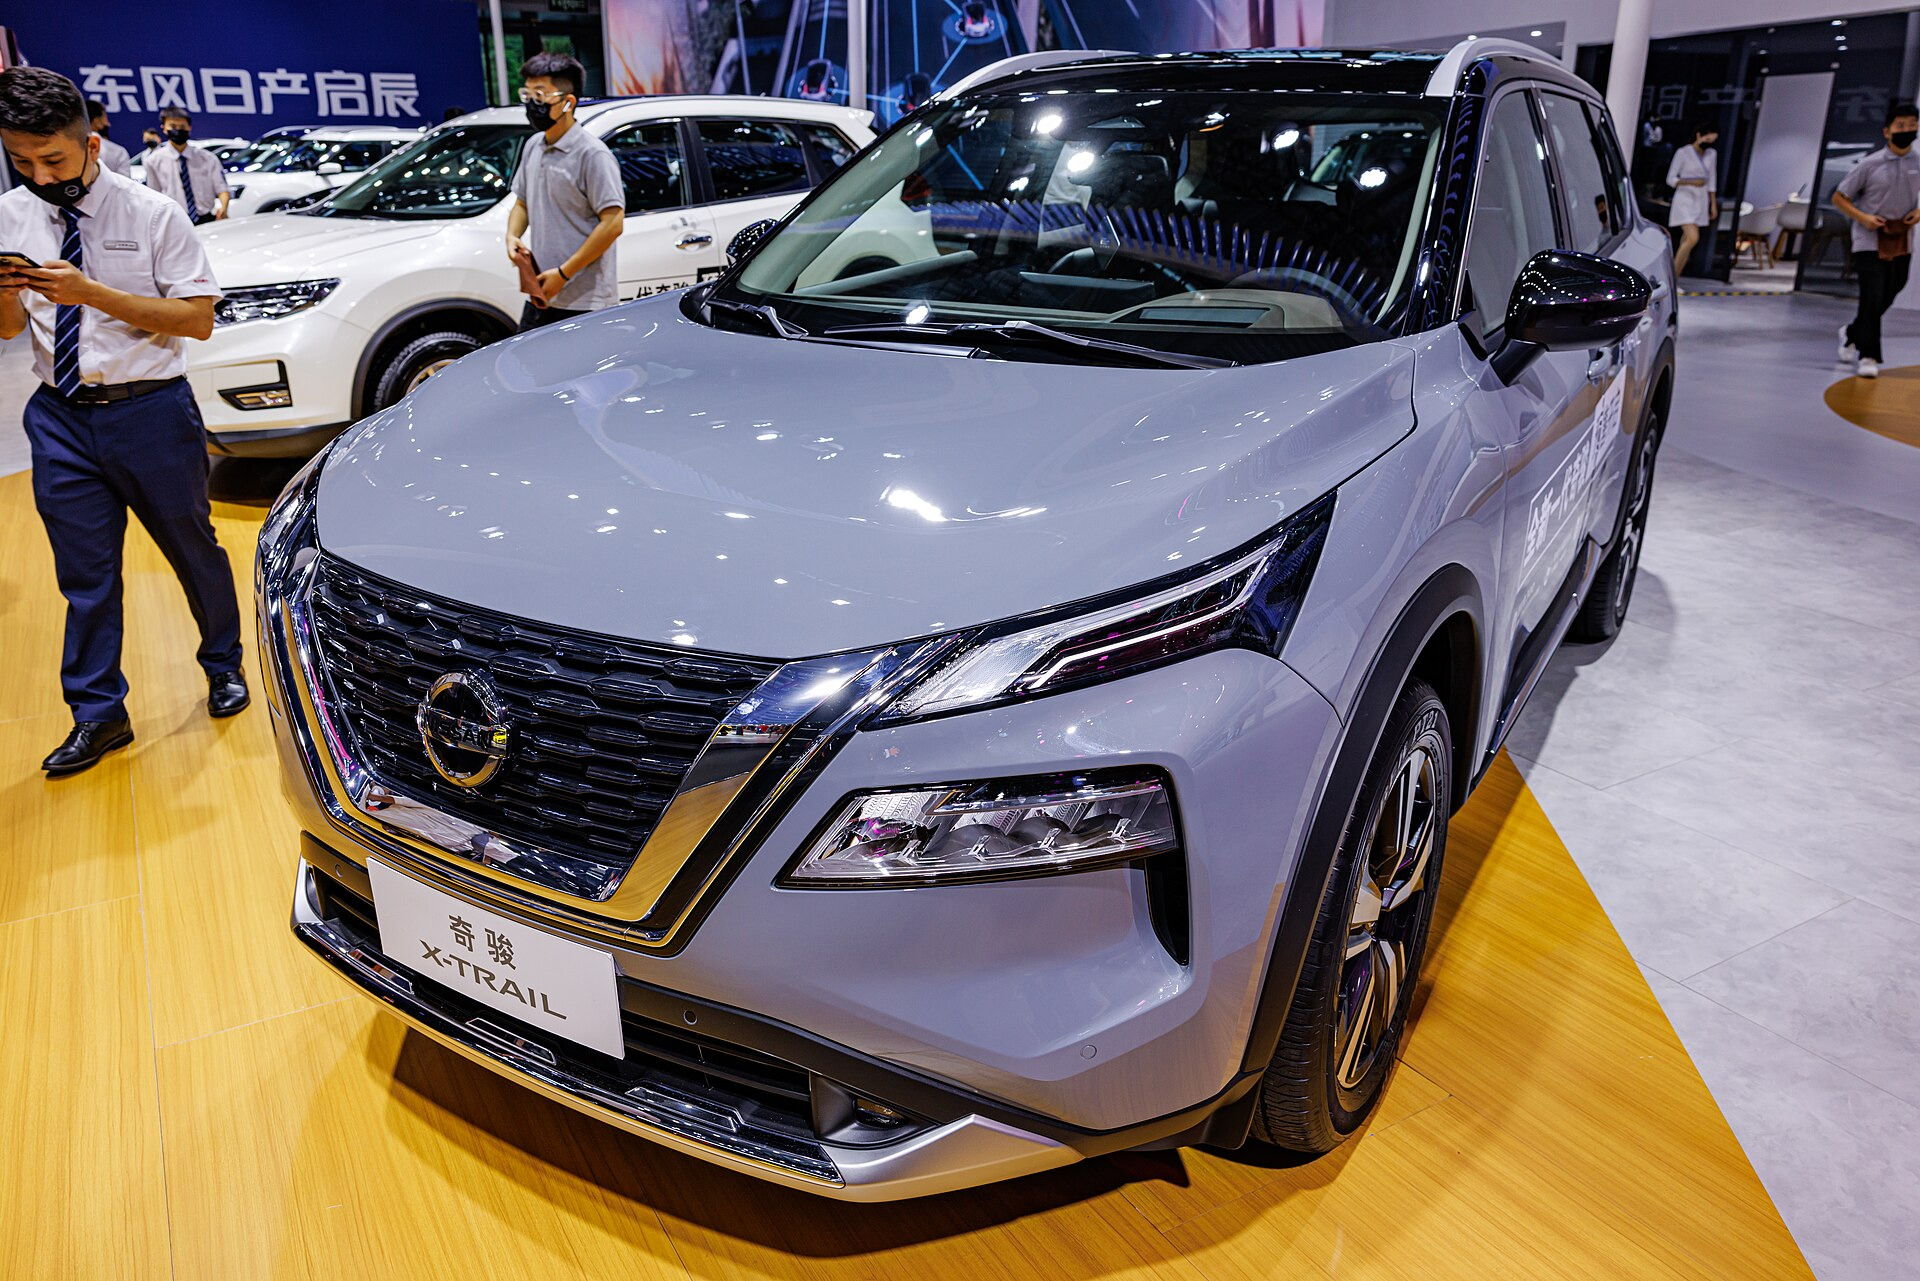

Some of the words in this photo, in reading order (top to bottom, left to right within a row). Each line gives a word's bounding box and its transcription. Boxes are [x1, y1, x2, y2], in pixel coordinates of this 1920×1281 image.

[79, 64, 421, 117] 东风日产启辰
[448, 914, 517, 971] 奇骏
[419, 939, 568, 1020] X-TRAIL
